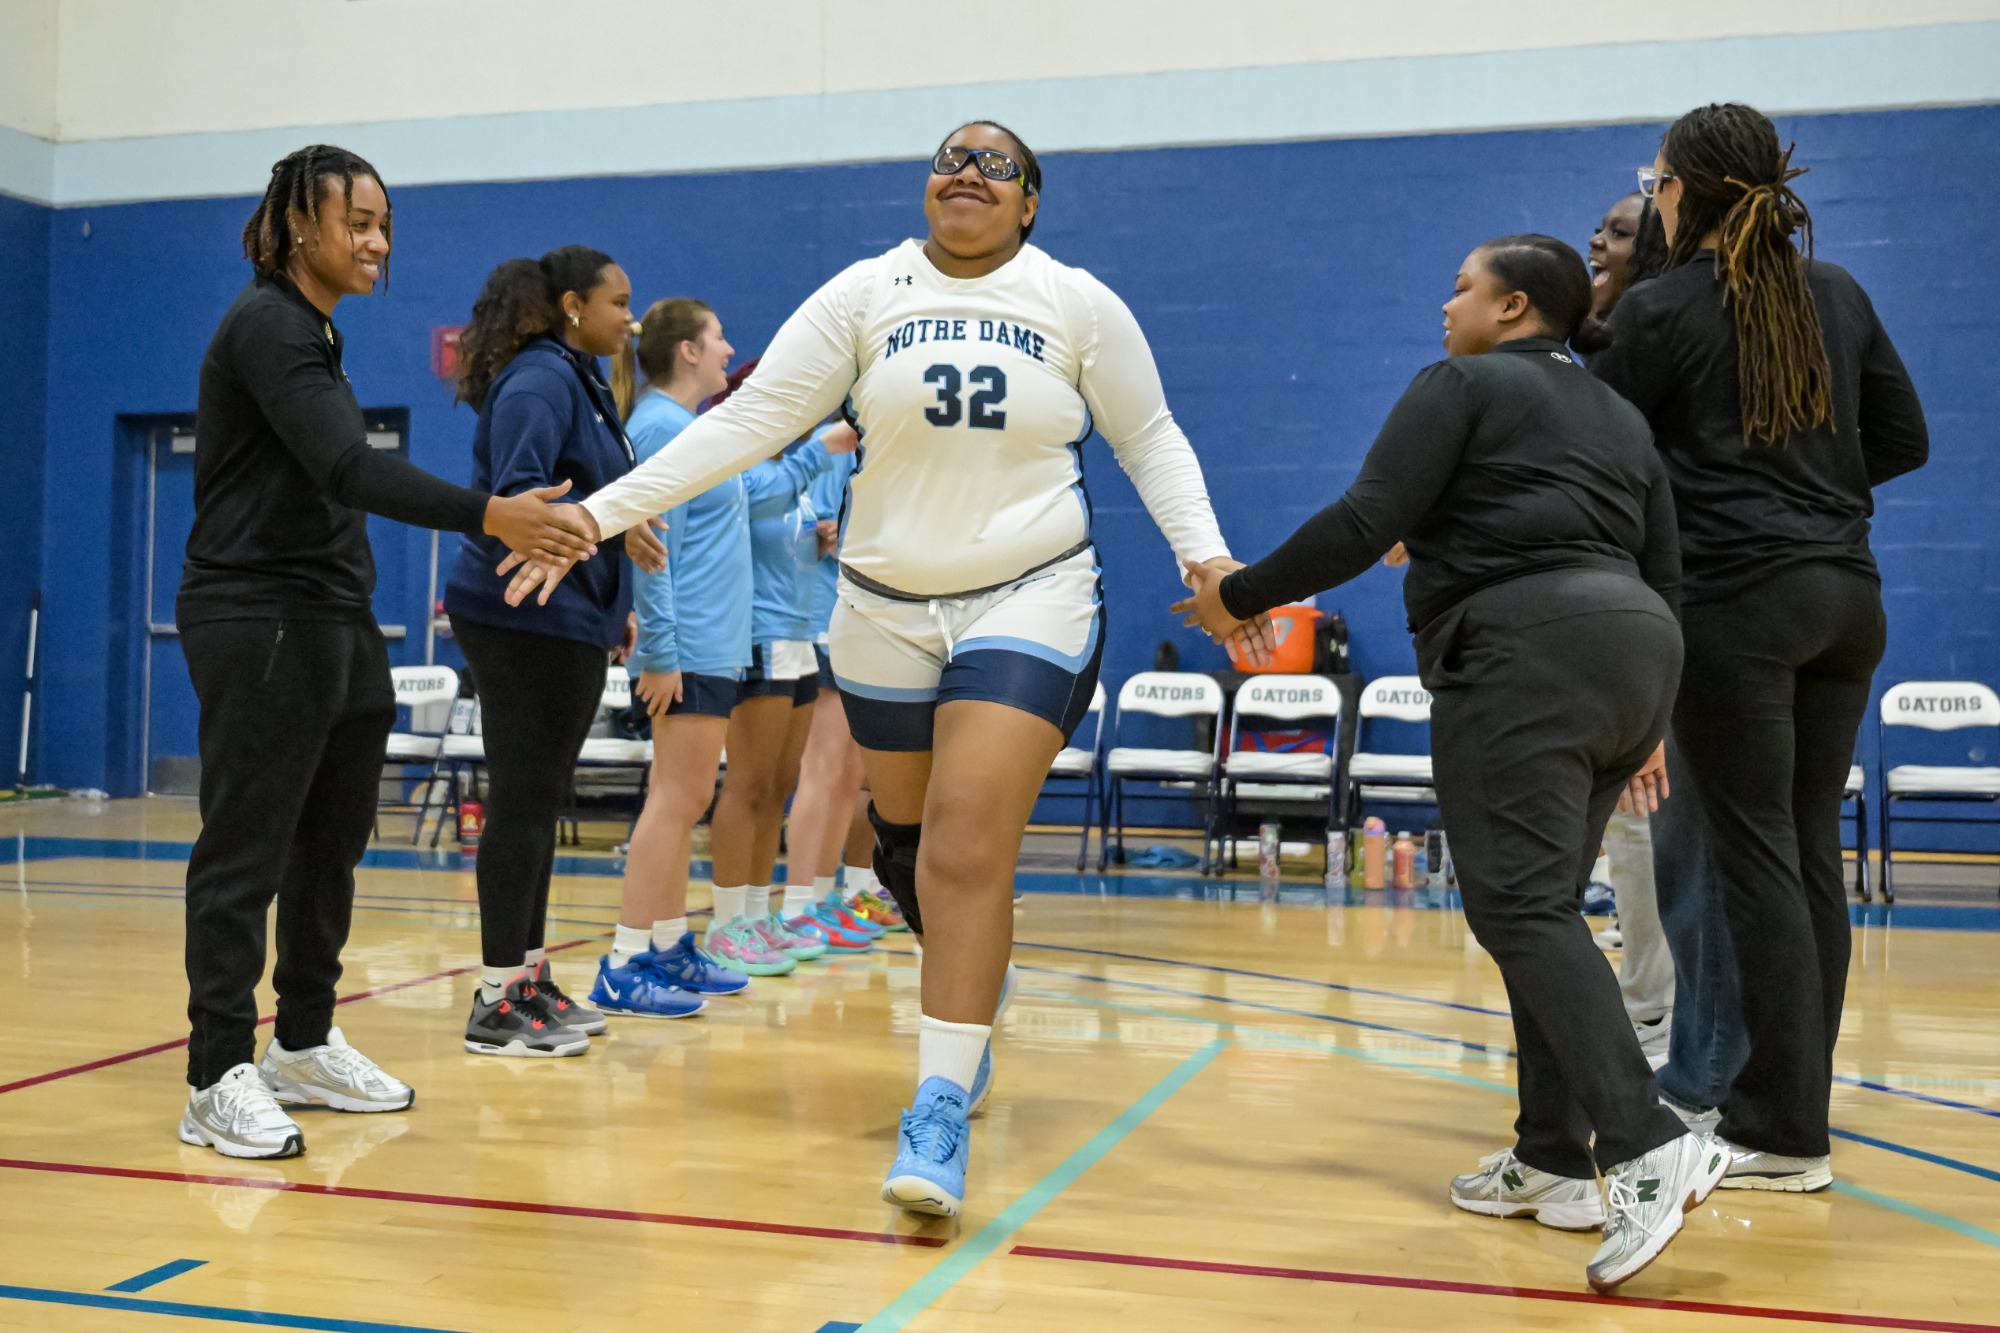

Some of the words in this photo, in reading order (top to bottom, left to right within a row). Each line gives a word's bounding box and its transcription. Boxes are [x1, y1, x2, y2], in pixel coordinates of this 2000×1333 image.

[885, 319, 967, 360] NOTRE
[979, 319, 1046, 363] DAME
[922, 363, 1008, 431] 32
[393, 677, 446, 692] ATORS
[1134, 684, 1205, 701] GATORS
[1251, 687, 1323, 703] GATORS
[1376, 689, 1433, 704] GATO
[1898, 695, 1982, 713] GATORS
[1635, 1178, 1661, 1203] N
